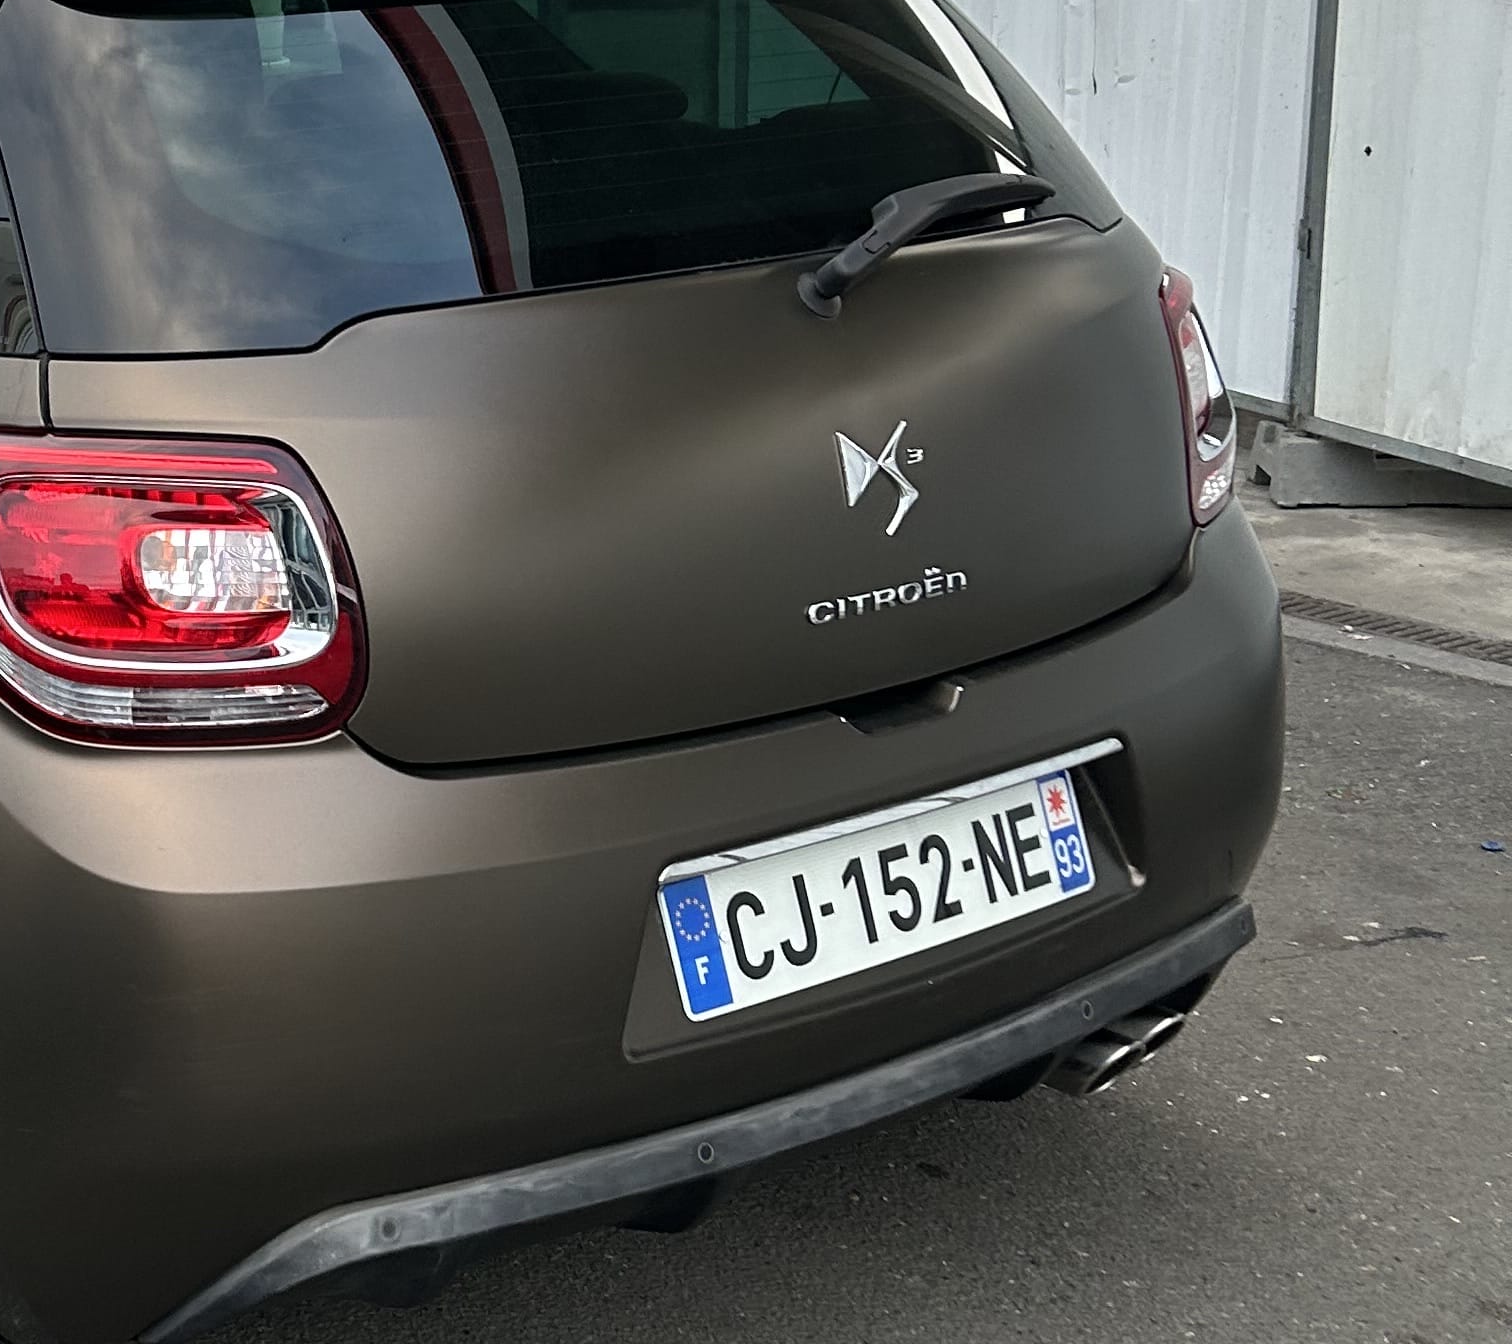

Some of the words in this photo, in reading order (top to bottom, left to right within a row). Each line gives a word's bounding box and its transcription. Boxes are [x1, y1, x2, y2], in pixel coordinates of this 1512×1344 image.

[906, 447, 924, 464] 3
[1054, 834, 1085, 878] 93
[726, 803, 1051, 980] CJ-152-NE
[695, 956, 711, 985] F
